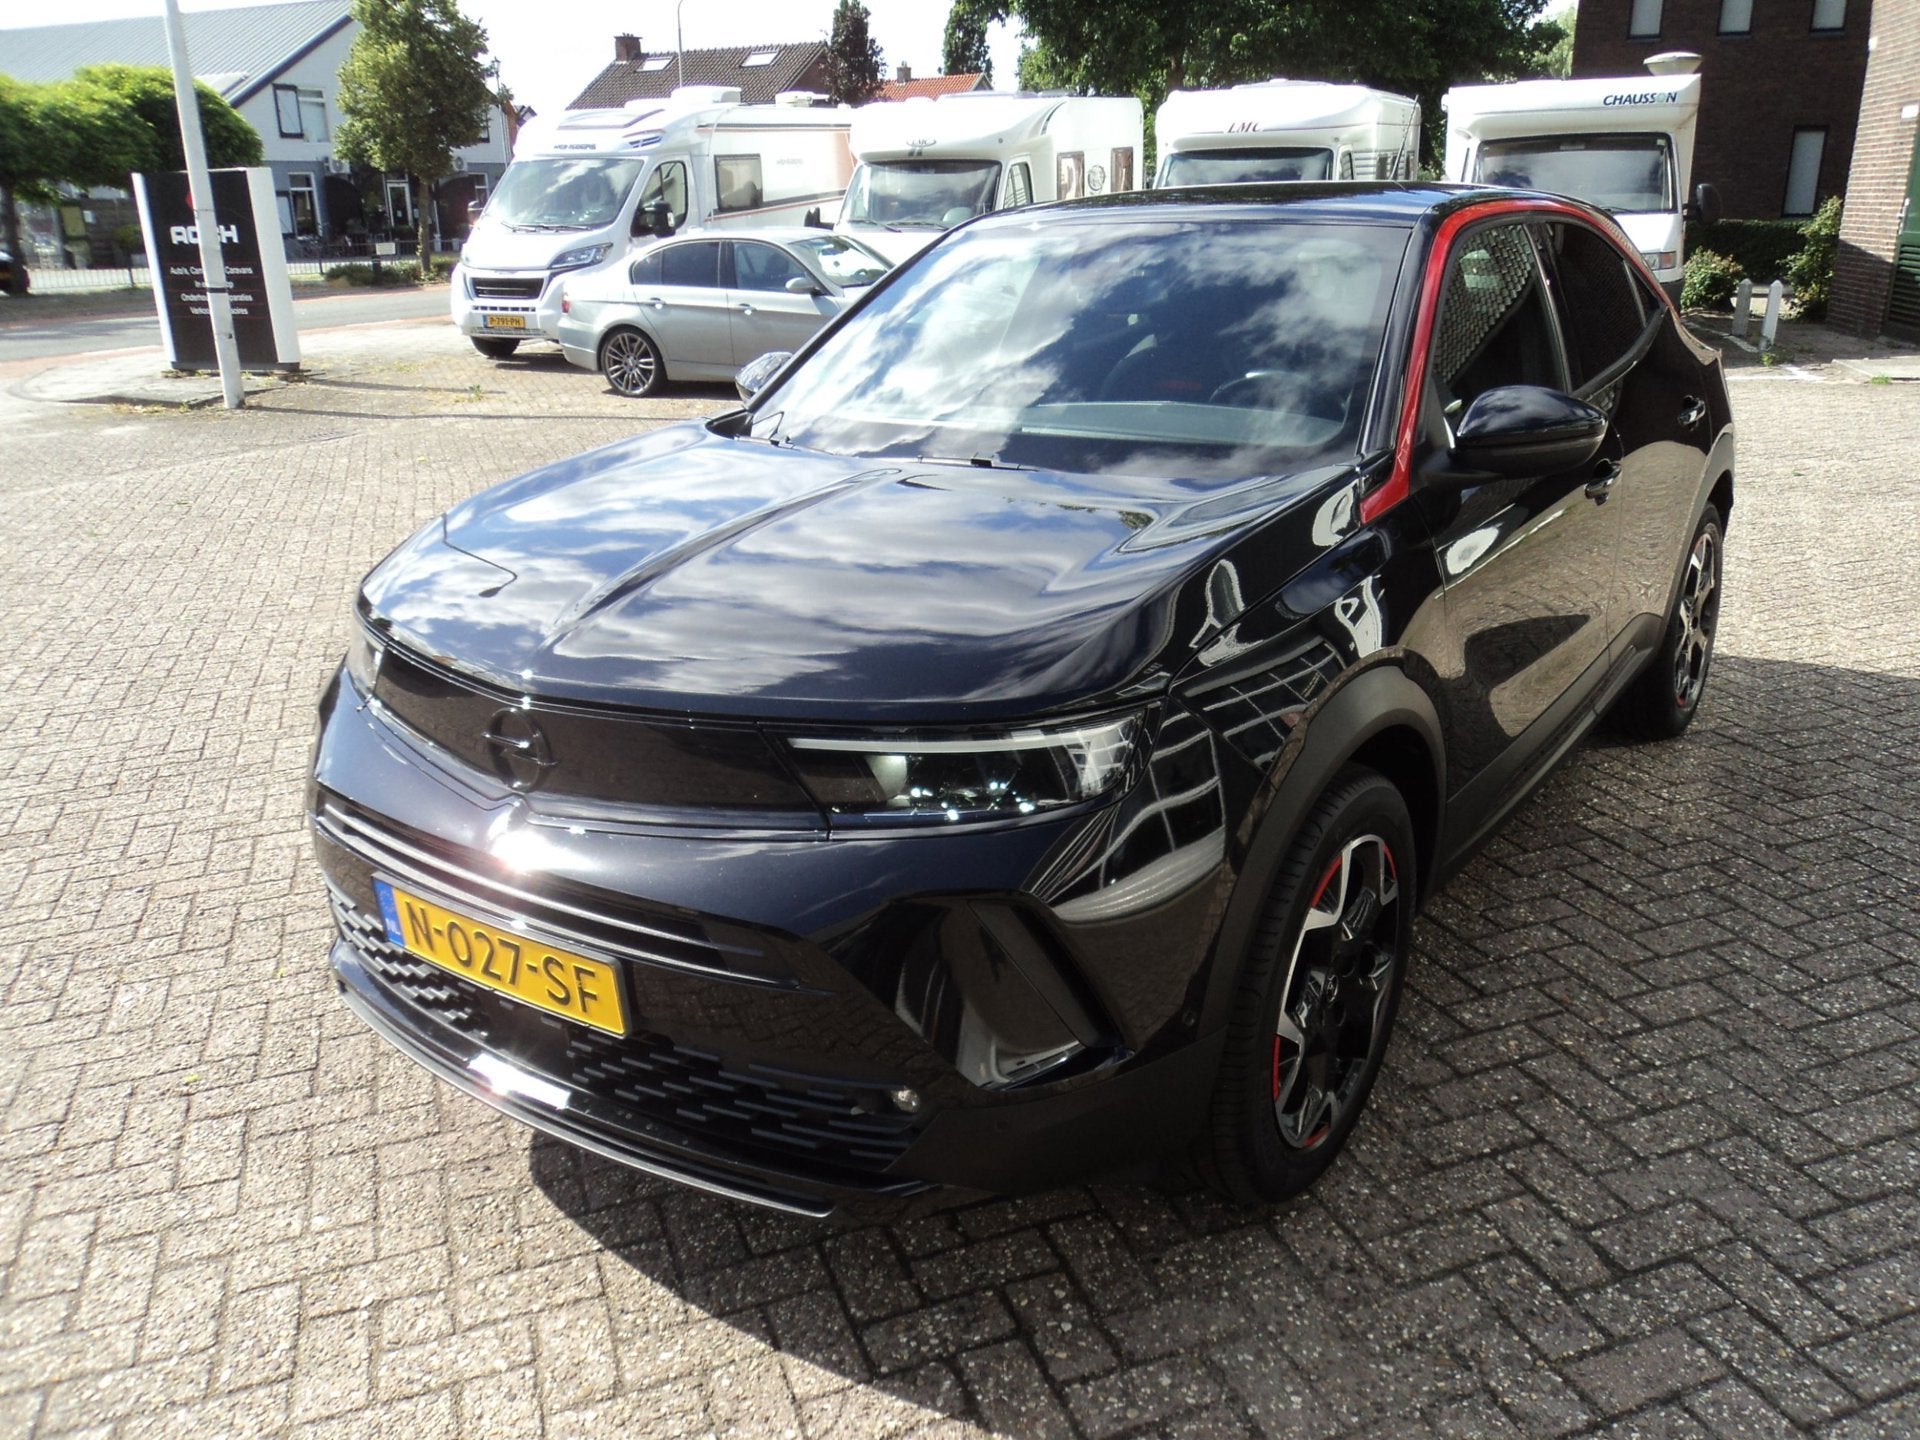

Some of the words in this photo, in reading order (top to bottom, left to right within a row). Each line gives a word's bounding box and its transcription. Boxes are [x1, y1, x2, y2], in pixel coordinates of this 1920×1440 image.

[1603, 92, 1678, 106] CHAUSSON
[1227, 121, 1259, 133] LMC
[404, 900, 599, 1014] N-027-SF
